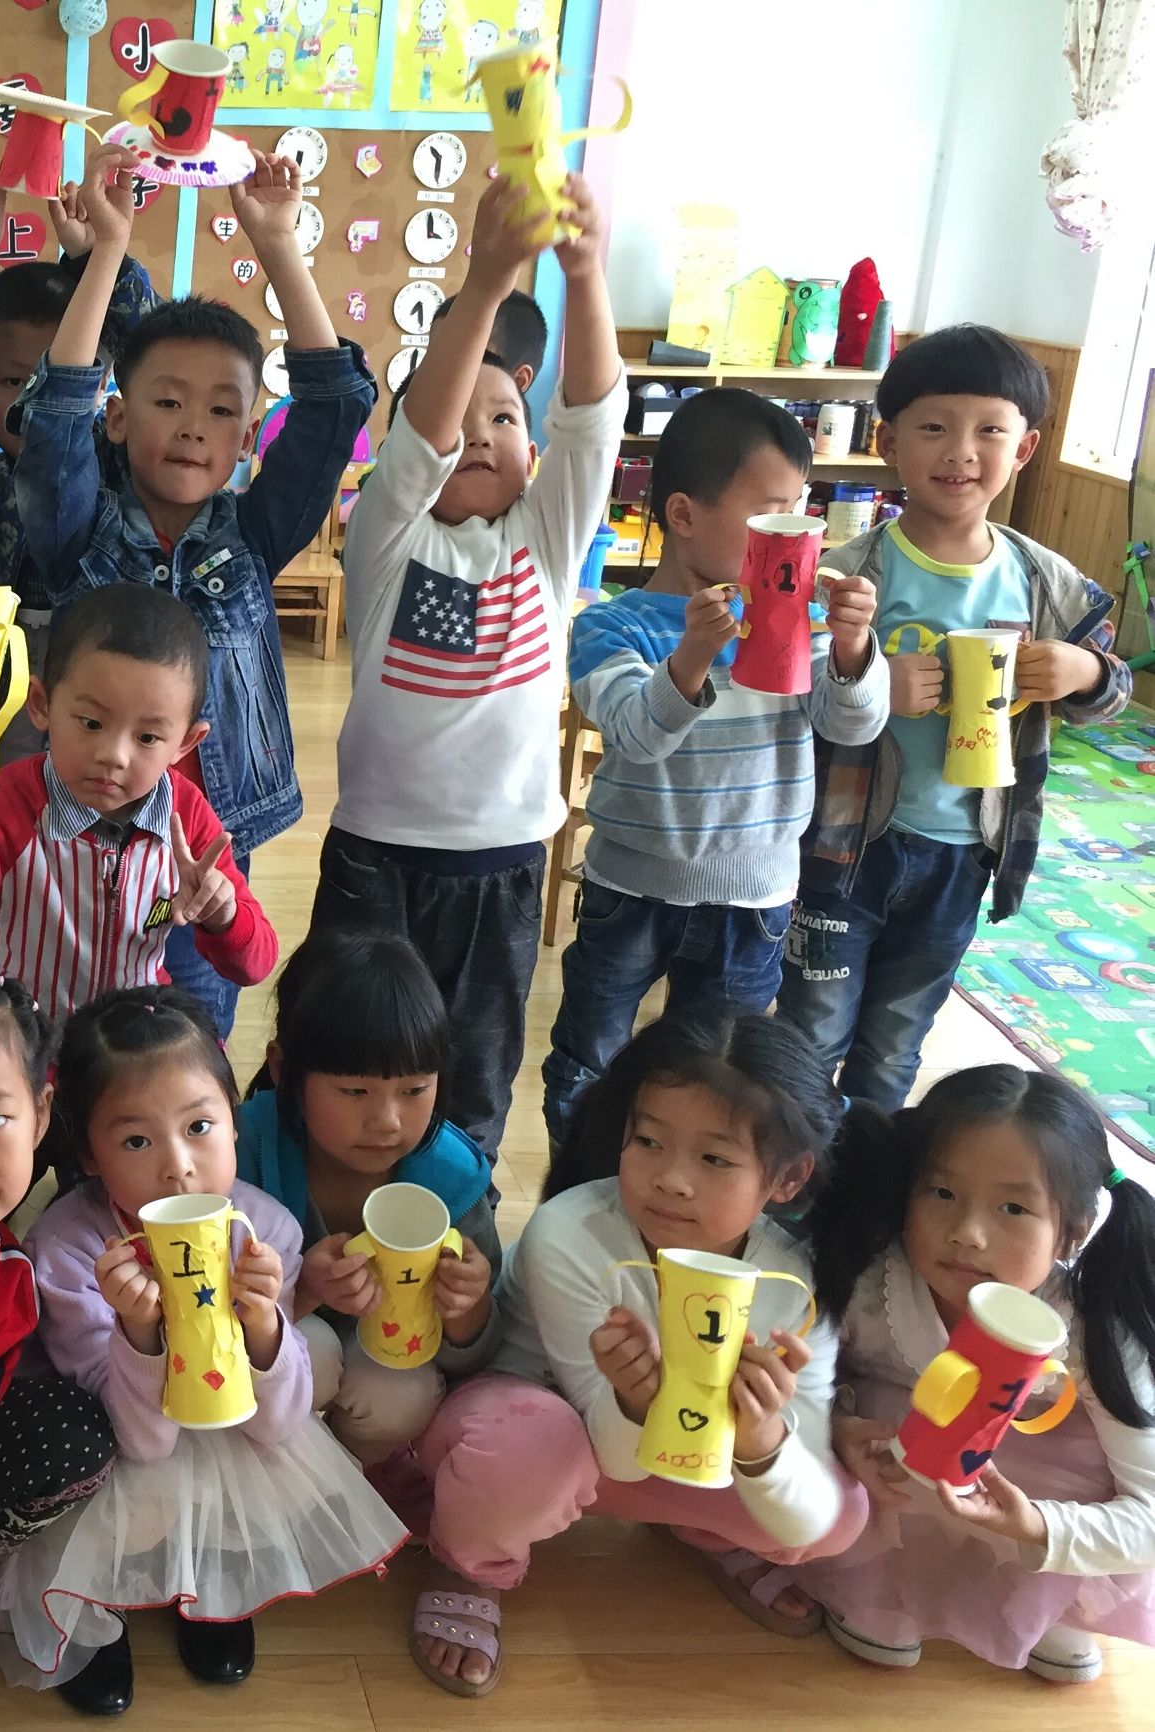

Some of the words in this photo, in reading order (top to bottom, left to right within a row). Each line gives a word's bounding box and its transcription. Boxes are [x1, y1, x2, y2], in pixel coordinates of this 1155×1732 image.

[778, 563, 796, 593] 1
[794, 911, 850, 933] AVIATOR
[802, 966, 851, 982] SQUAD
[396, 1267, 421, 1285] 1
[697, 1309, 727, 1344] 1
